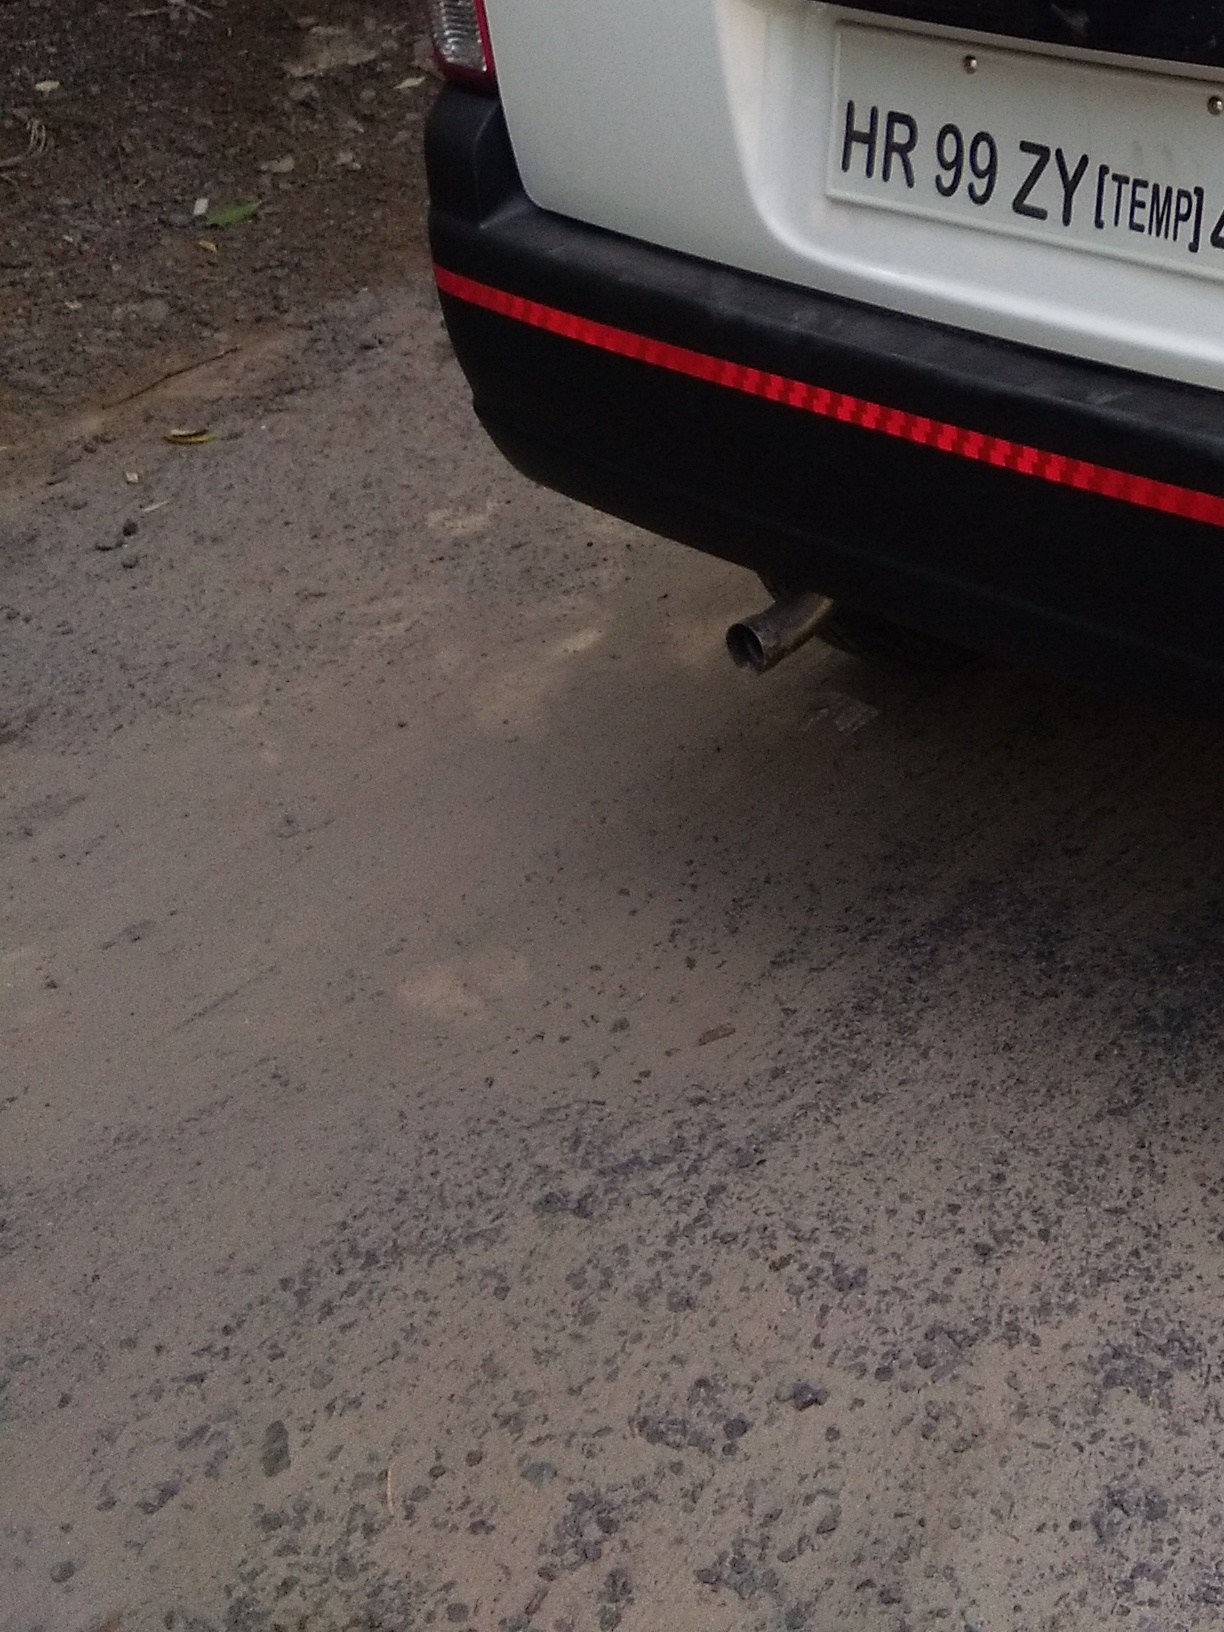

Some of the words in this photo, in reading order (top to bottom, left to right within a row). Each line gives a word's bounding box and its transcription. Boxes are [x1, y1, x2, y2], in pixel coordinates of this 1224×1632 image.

[841, 99, 919, 188] HR
[935, 122, 998, 205] 99
[1011, 140, 1089, 227] ZY
